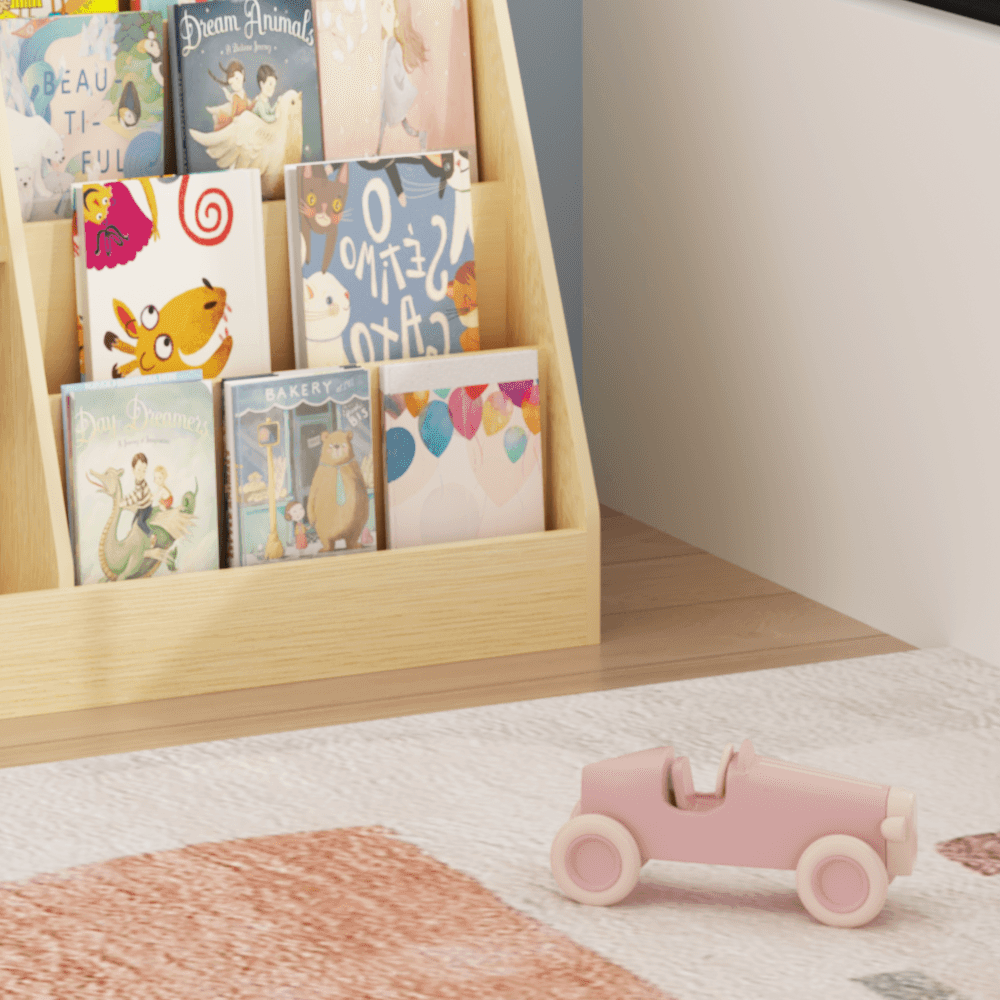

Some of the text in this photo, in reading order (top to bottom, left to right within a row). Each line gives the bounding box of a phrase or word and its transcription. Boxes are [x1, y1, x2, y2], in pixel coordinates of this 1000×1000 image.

[180, 9, 240, 57] Dream
[81, 149, 124, 174] FUL
[265, 380, 332, 402] BAKERY
[74, 406, 116, 443] Day
